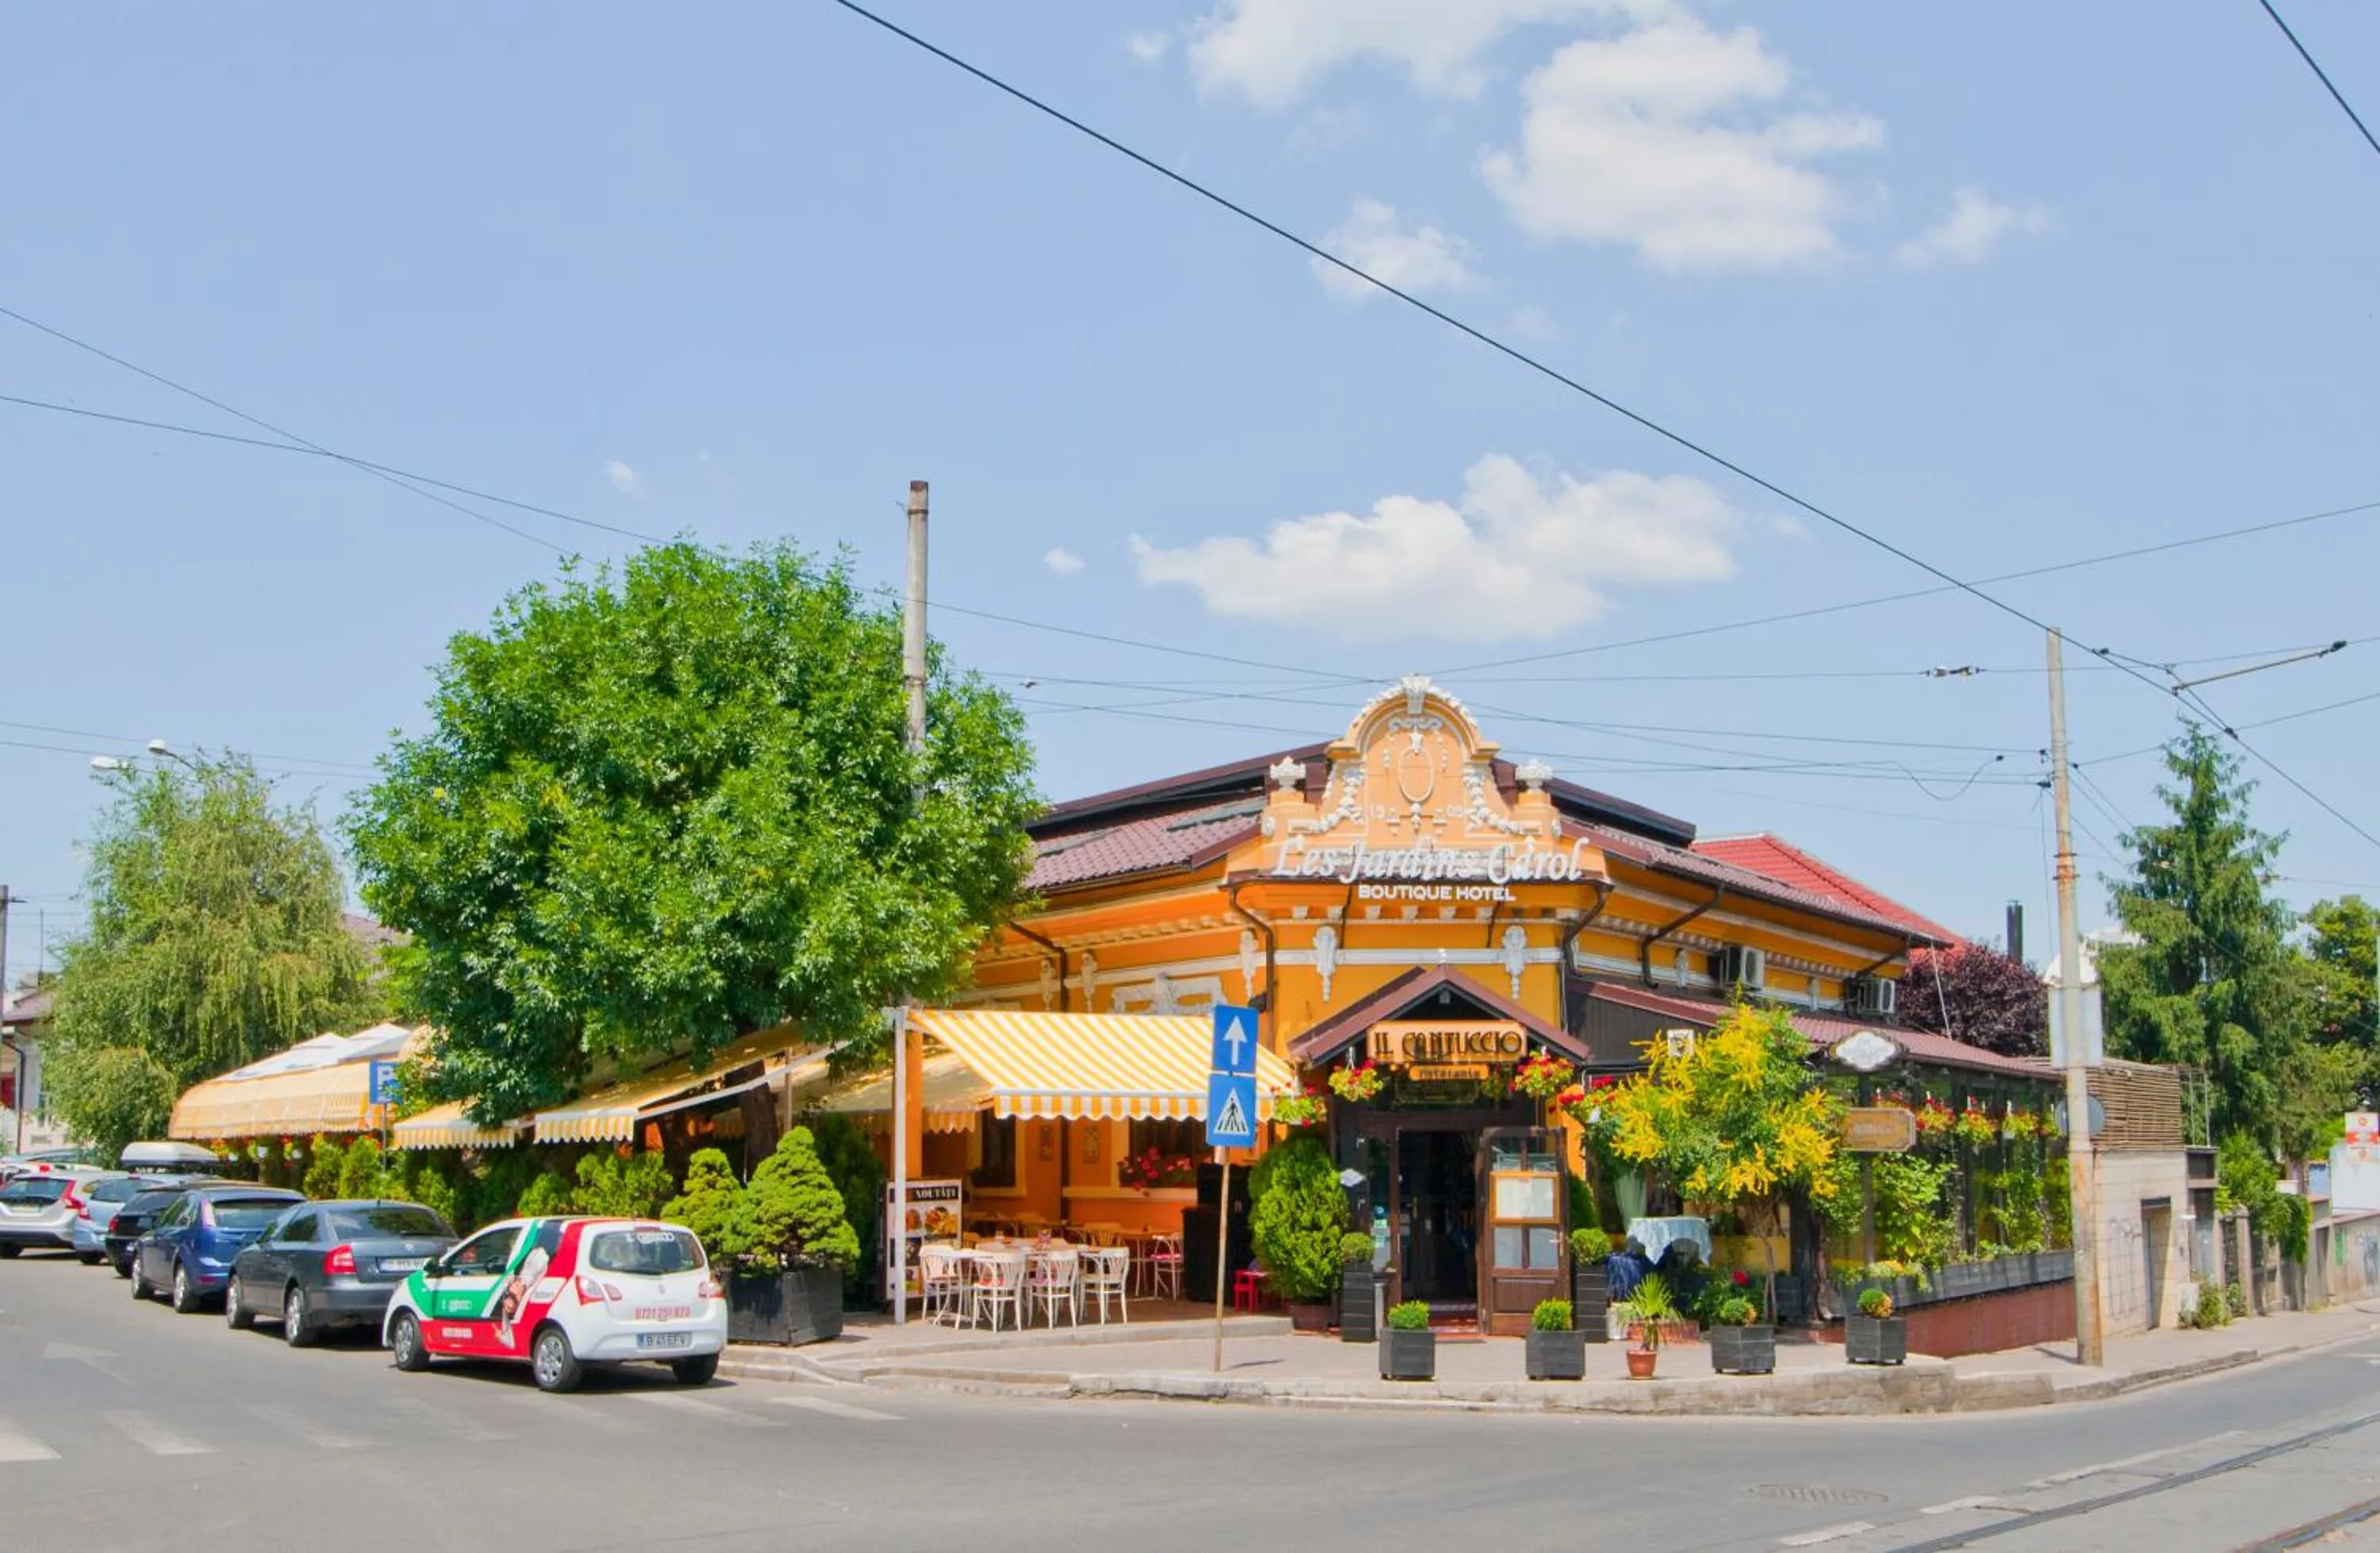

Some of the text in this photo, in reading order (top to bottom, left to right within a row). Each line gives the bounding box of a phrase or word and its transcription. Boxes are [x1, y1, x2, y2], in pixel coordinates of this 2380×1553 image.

[1273, 836, 1338, 876] Les
[1488, 837, 1589, 884] Carol
[1358, 884, 1515, 901] BOUTIQUE HOTEL
[1375, 1030, 1522, 1056] IL CANTUCCIO
